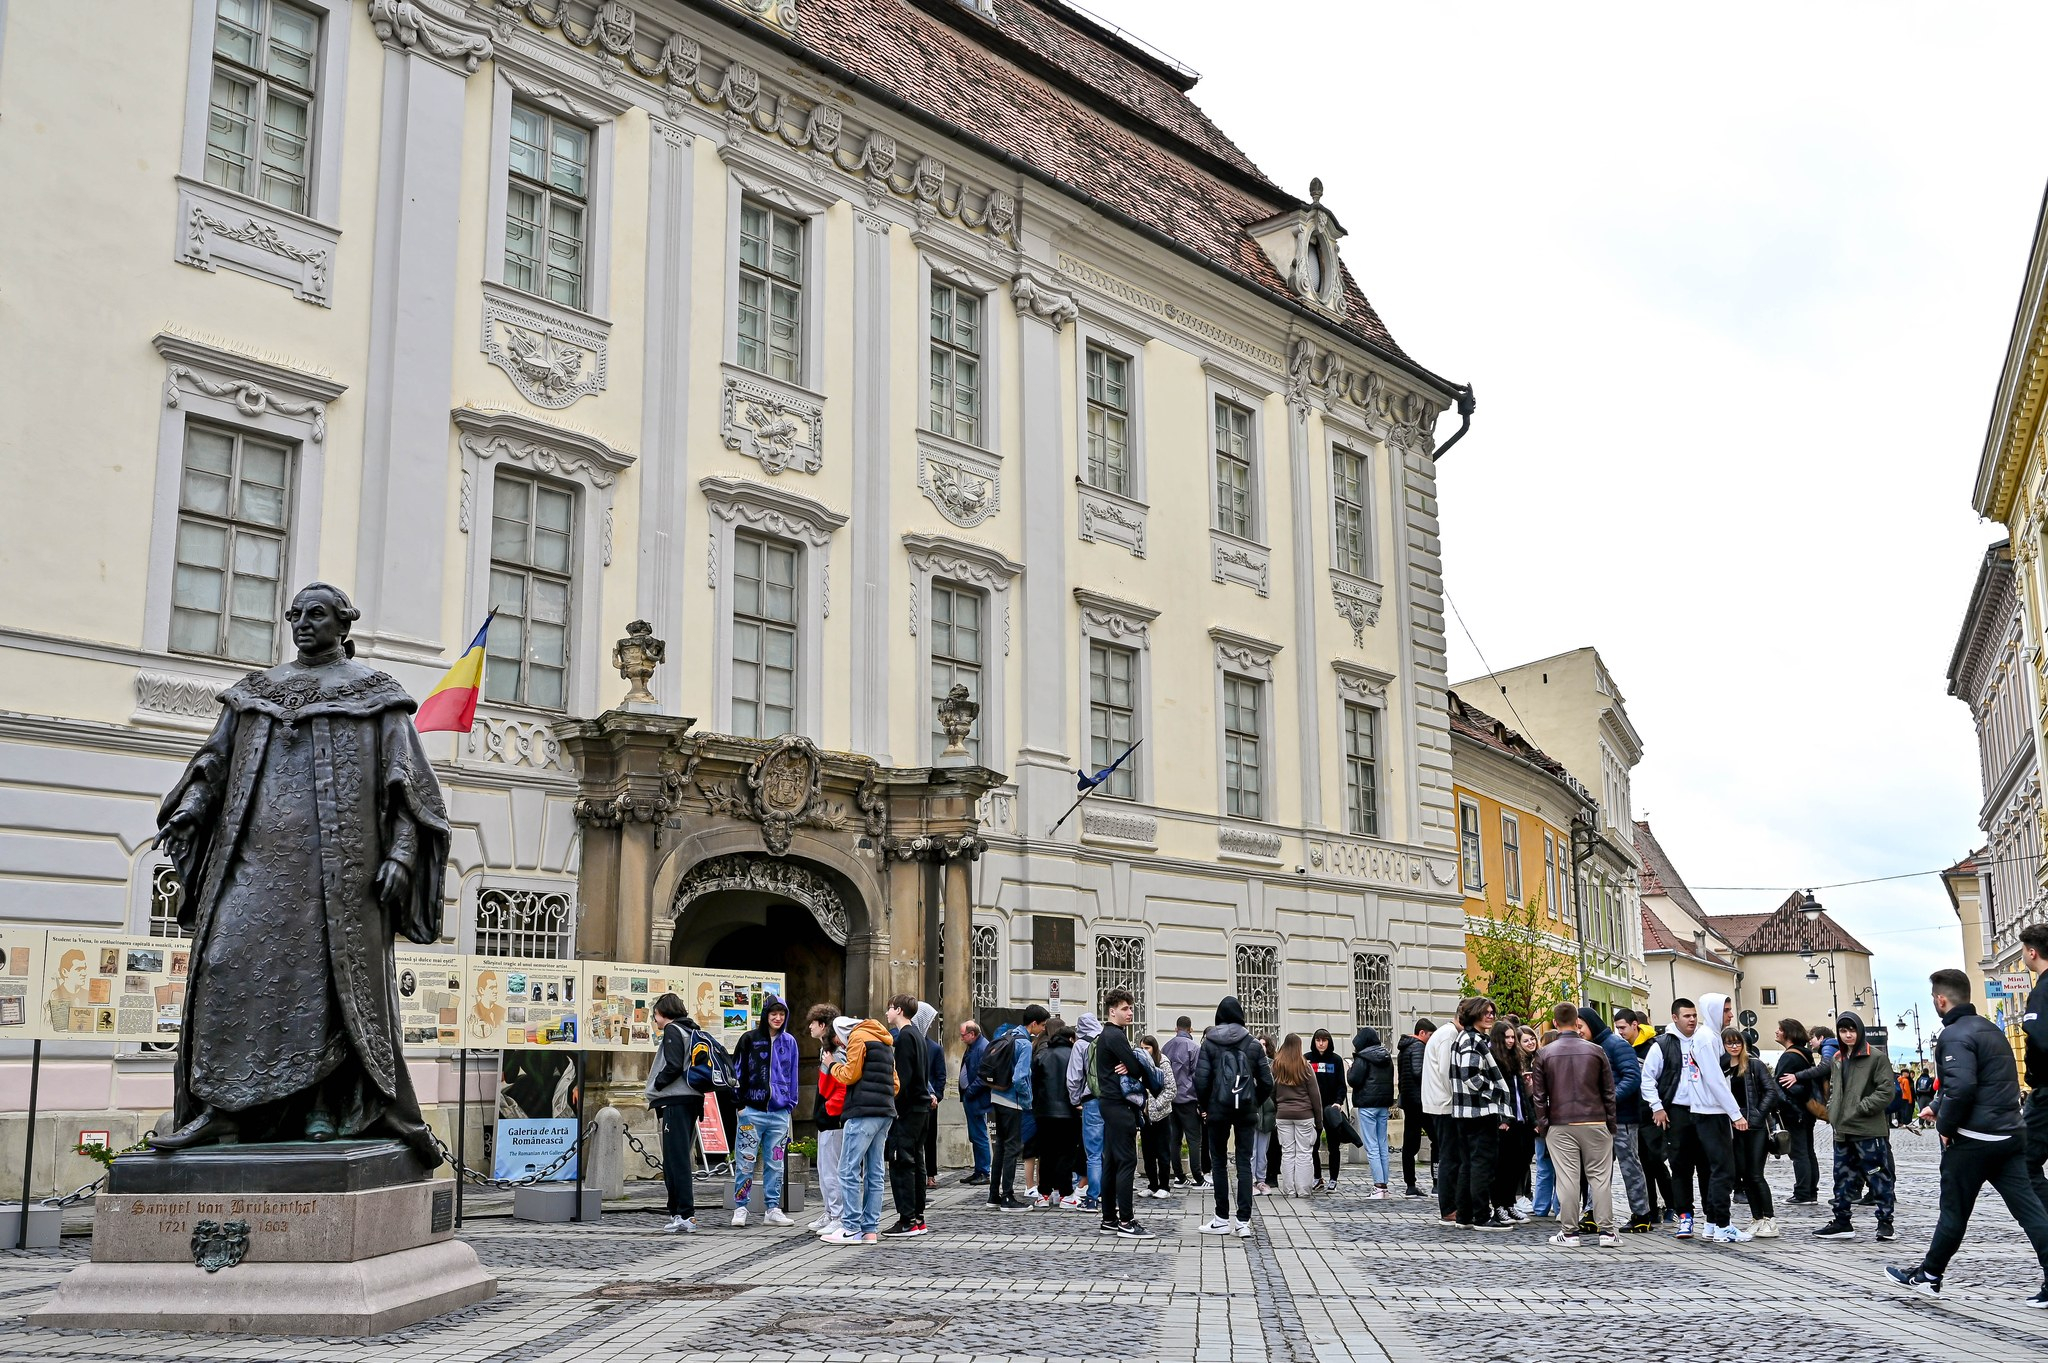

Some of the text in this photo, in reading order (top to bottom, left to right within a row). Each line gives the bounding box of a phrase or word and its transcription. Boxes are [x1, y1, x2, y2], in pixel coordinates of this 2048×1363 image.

[508, 1127, 569, 1136] Galeria de Artă
[512, 1137, 564, 1146] Românească
[131, 1199, 317, 1216] Samuel von Brukenthal
[159, 1221, 186, 1233] 1721
